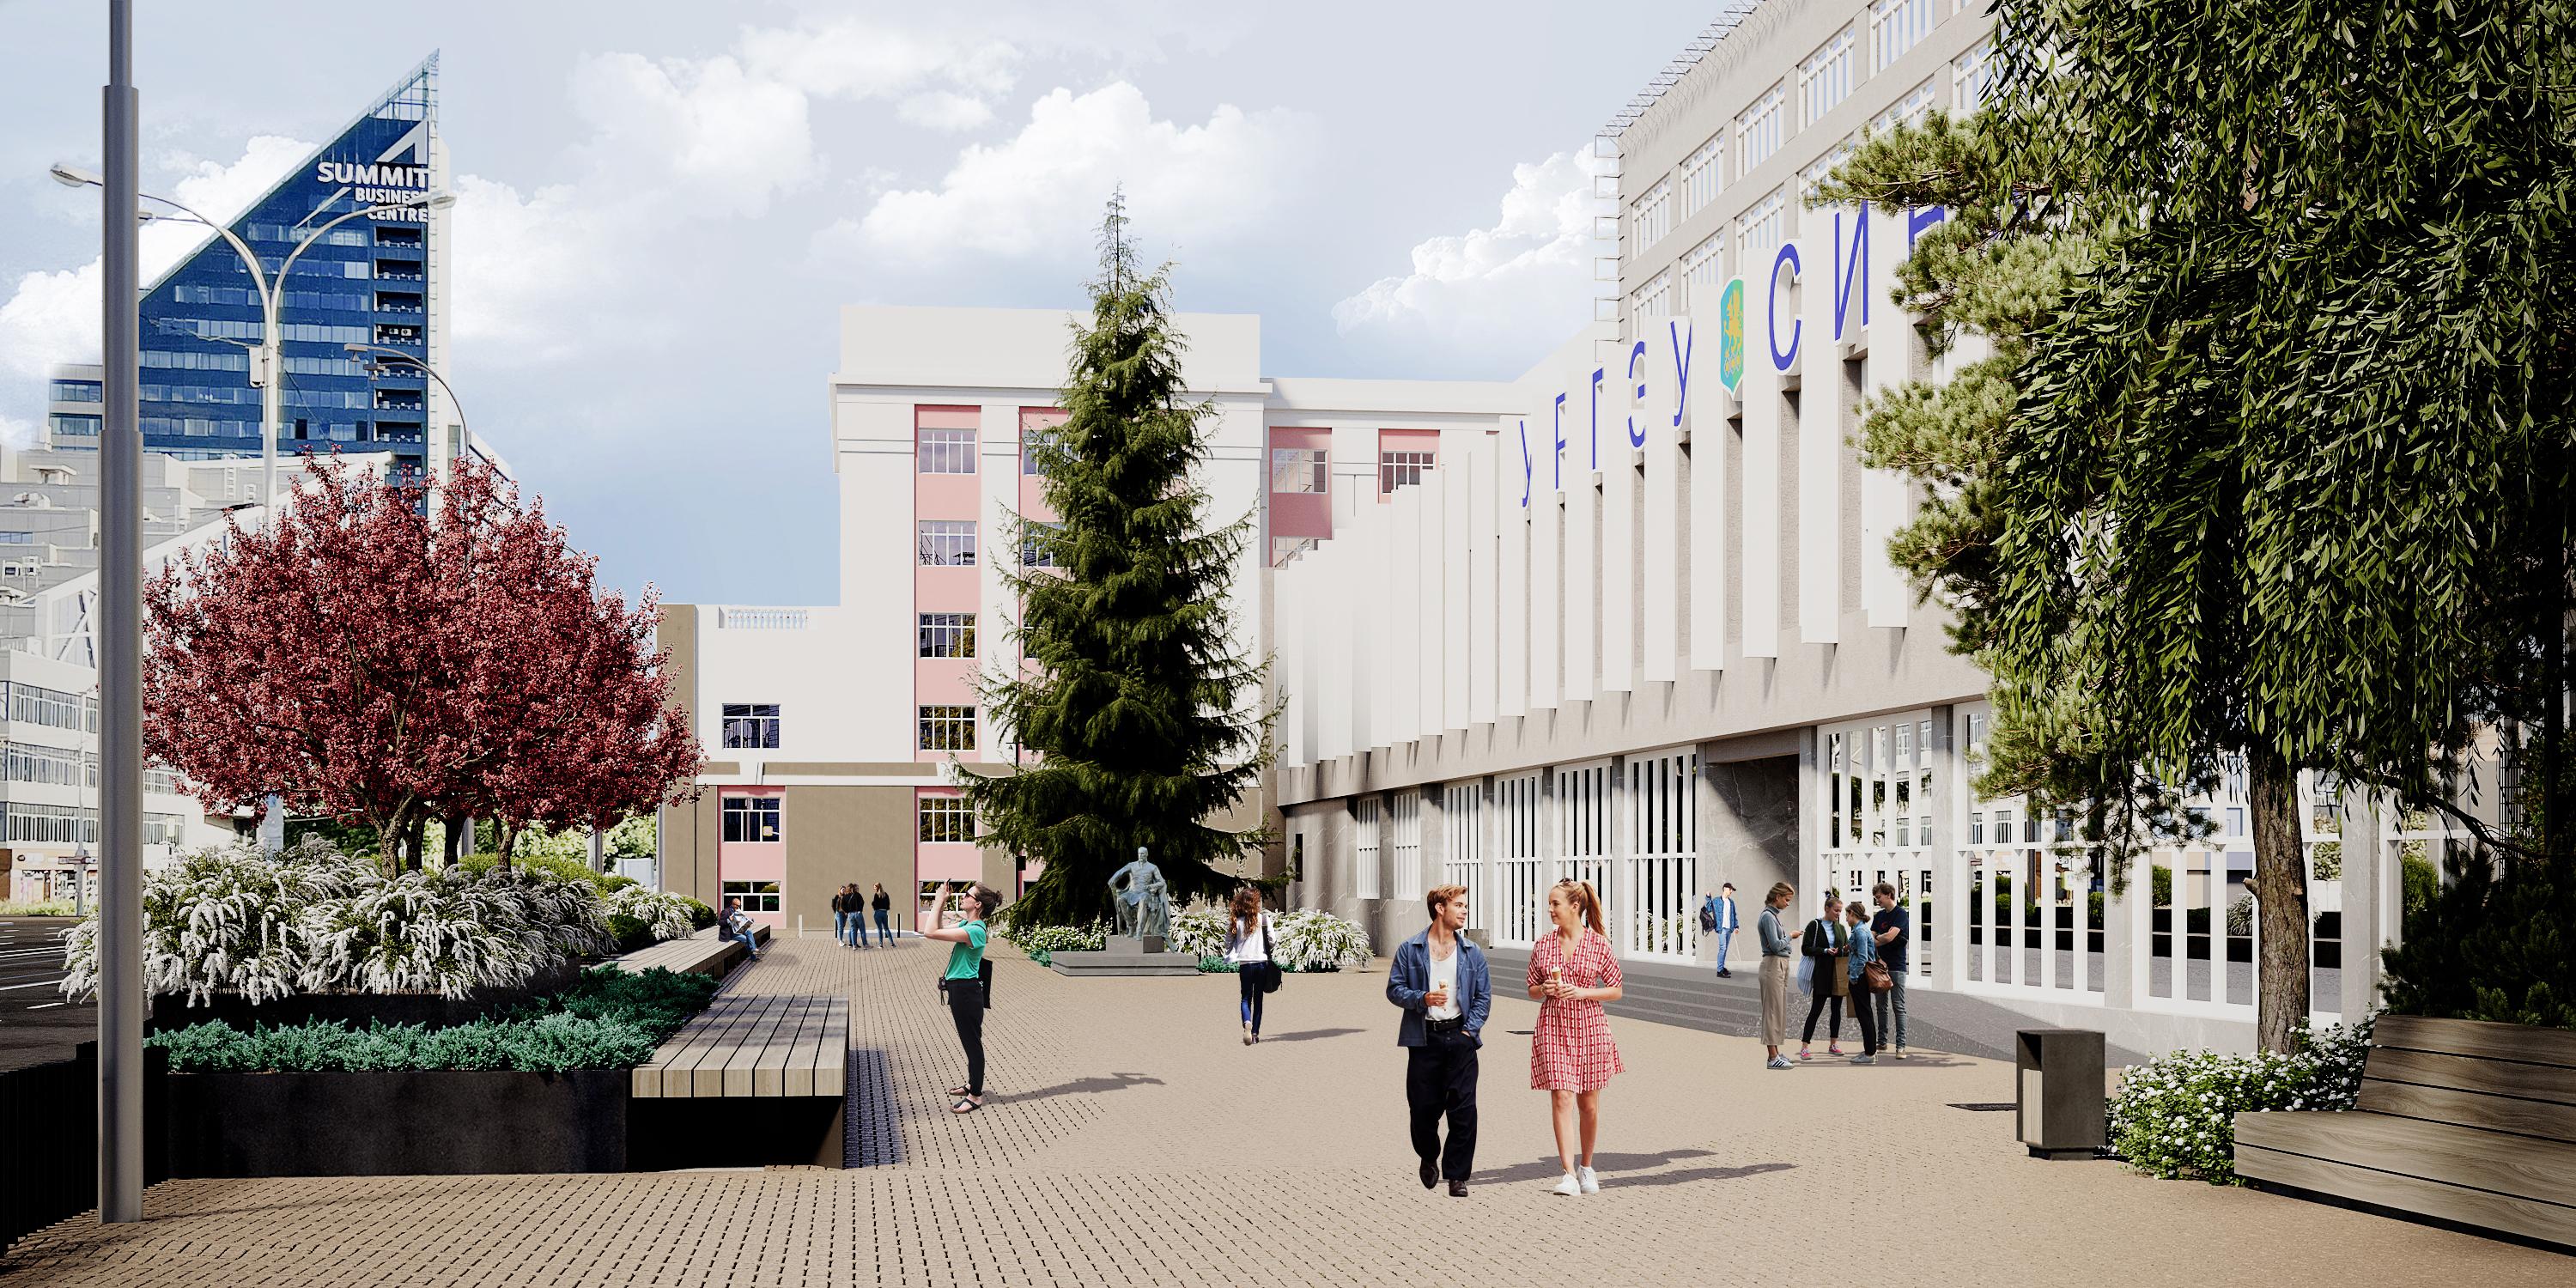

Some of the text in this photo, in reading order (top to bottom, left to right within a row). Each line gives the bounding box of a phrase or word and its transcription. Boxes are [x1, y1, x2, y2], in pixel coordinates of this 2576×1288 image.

[317, 161, 429, 188] SUMMIT
[355, 187, 429, 204] BUSINE
[367, 205, 428, 222] CENTRE
